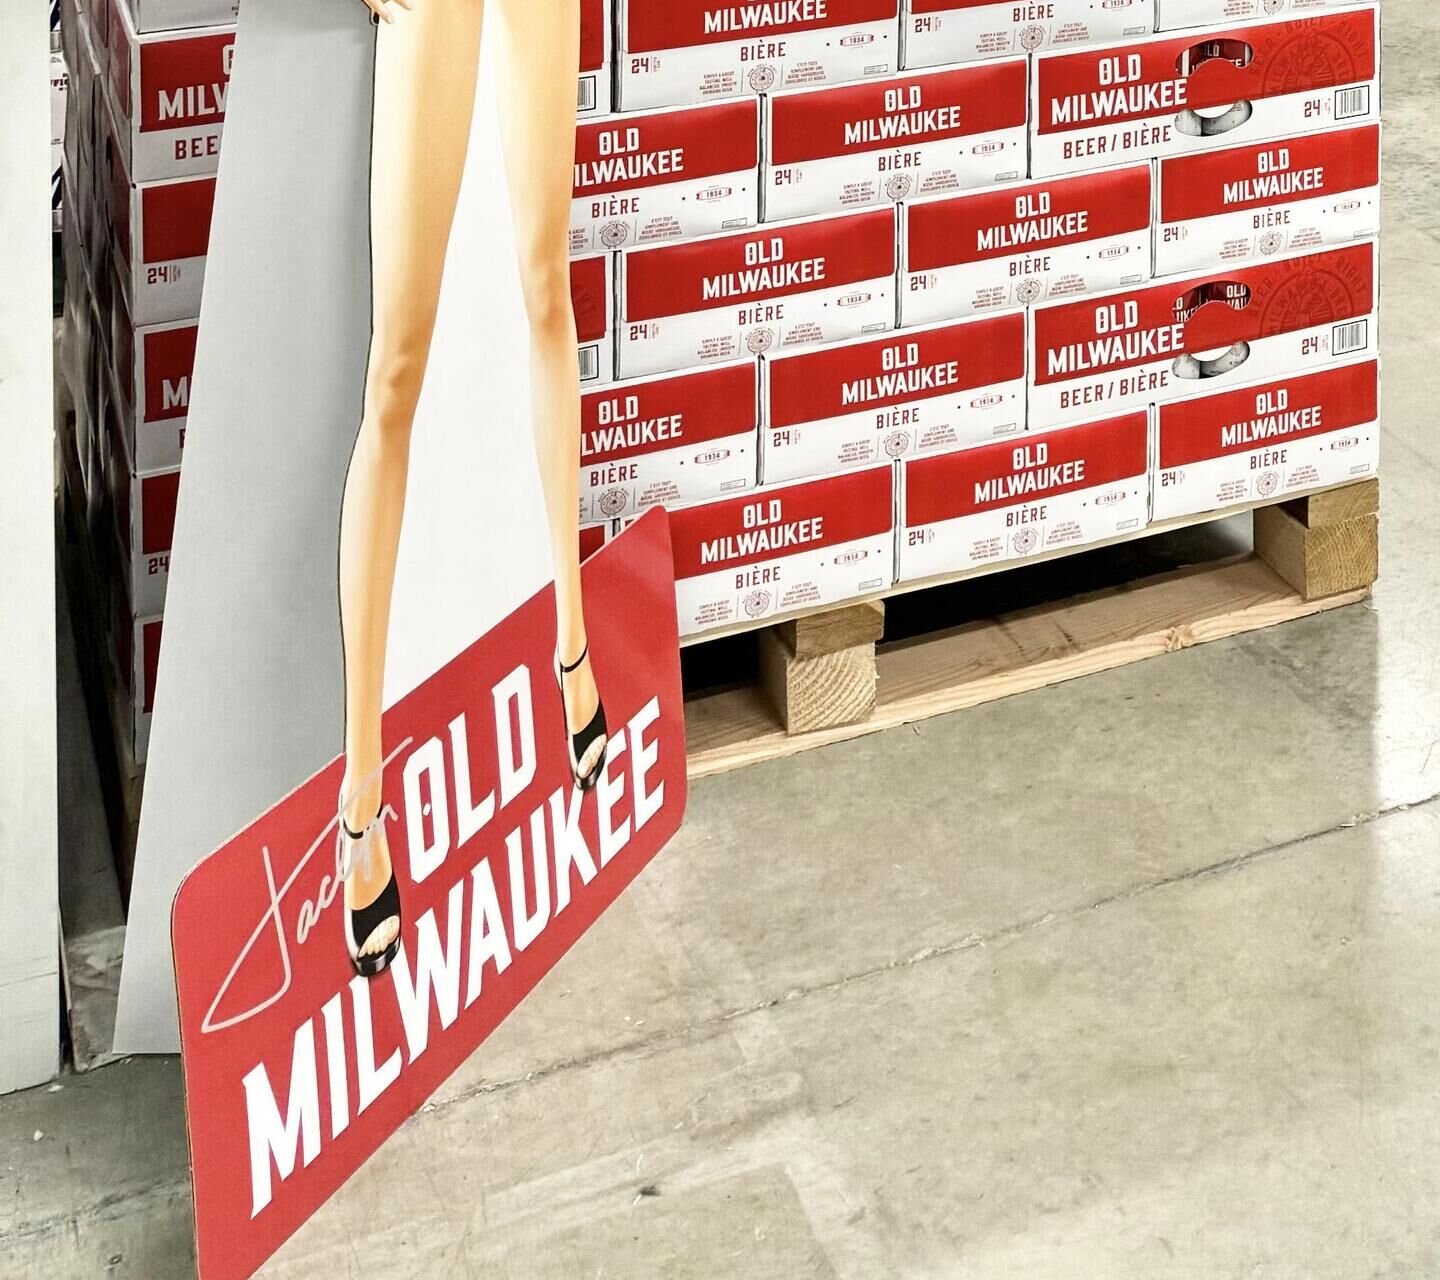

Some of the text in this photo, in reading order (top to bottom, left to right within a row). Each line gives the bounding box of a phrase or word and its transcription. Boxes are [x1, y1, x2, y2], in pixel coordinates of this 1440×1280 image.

[1013, 1, 1055, 23] BIÈRE
[631, 57, 650, 74] 24
[740, 38, 787, 63] BIÈRE
[1098, 53, 1142, 85] OLD
[884, 85, 922, 112] OLD
[1050, 77, 1188, 126] MILWAUKEE
[844, 105, 961, 146] MILWAUKEE
[598, 127, 640, 156] OLD
[575, 148, 684, 187] ILWAUKEE
[878, 150, 922, 172] BIÈRE
[1257, 147, 1290, 173] OLD
[1223, 167, 1324, 205] MILWAUKEE
[591, 195, 640, 219] BIÈRE
[1014, 191, 1051, 218] OLD
[976, 210, 1089, 252] MILWAUKEE
[744, 237, 784, 266] OLD
[702, 257, 826, 301] MILWAUKEE
[739, 303, 785, 326] BIÈRE
[1094, 300, 1139, 334] OLD
[881, 342, 919, 371] OLD
[1047, 321, 1185, 377] MILWAUKEE
[841, 360, 959, 406] MILWAUKEE
[598, 395, 639, 425] OLD
[1256, 388, 1288, 415] OLD
[581, 413, 683, 458] LWAUKEE
[1221, 407, 1322, 448] MILWAUKEE
[1012, 442, 1048, 470] OLD
[974, 459, 1085, 506] MILWAUKEE
[743, 499, 782, 528] OLD
[701, 516, 824, 566] MILWAUKEE
[402, 662, 538, 885] OLD
[242, 695, 665, 1220] MILWAUKEE
